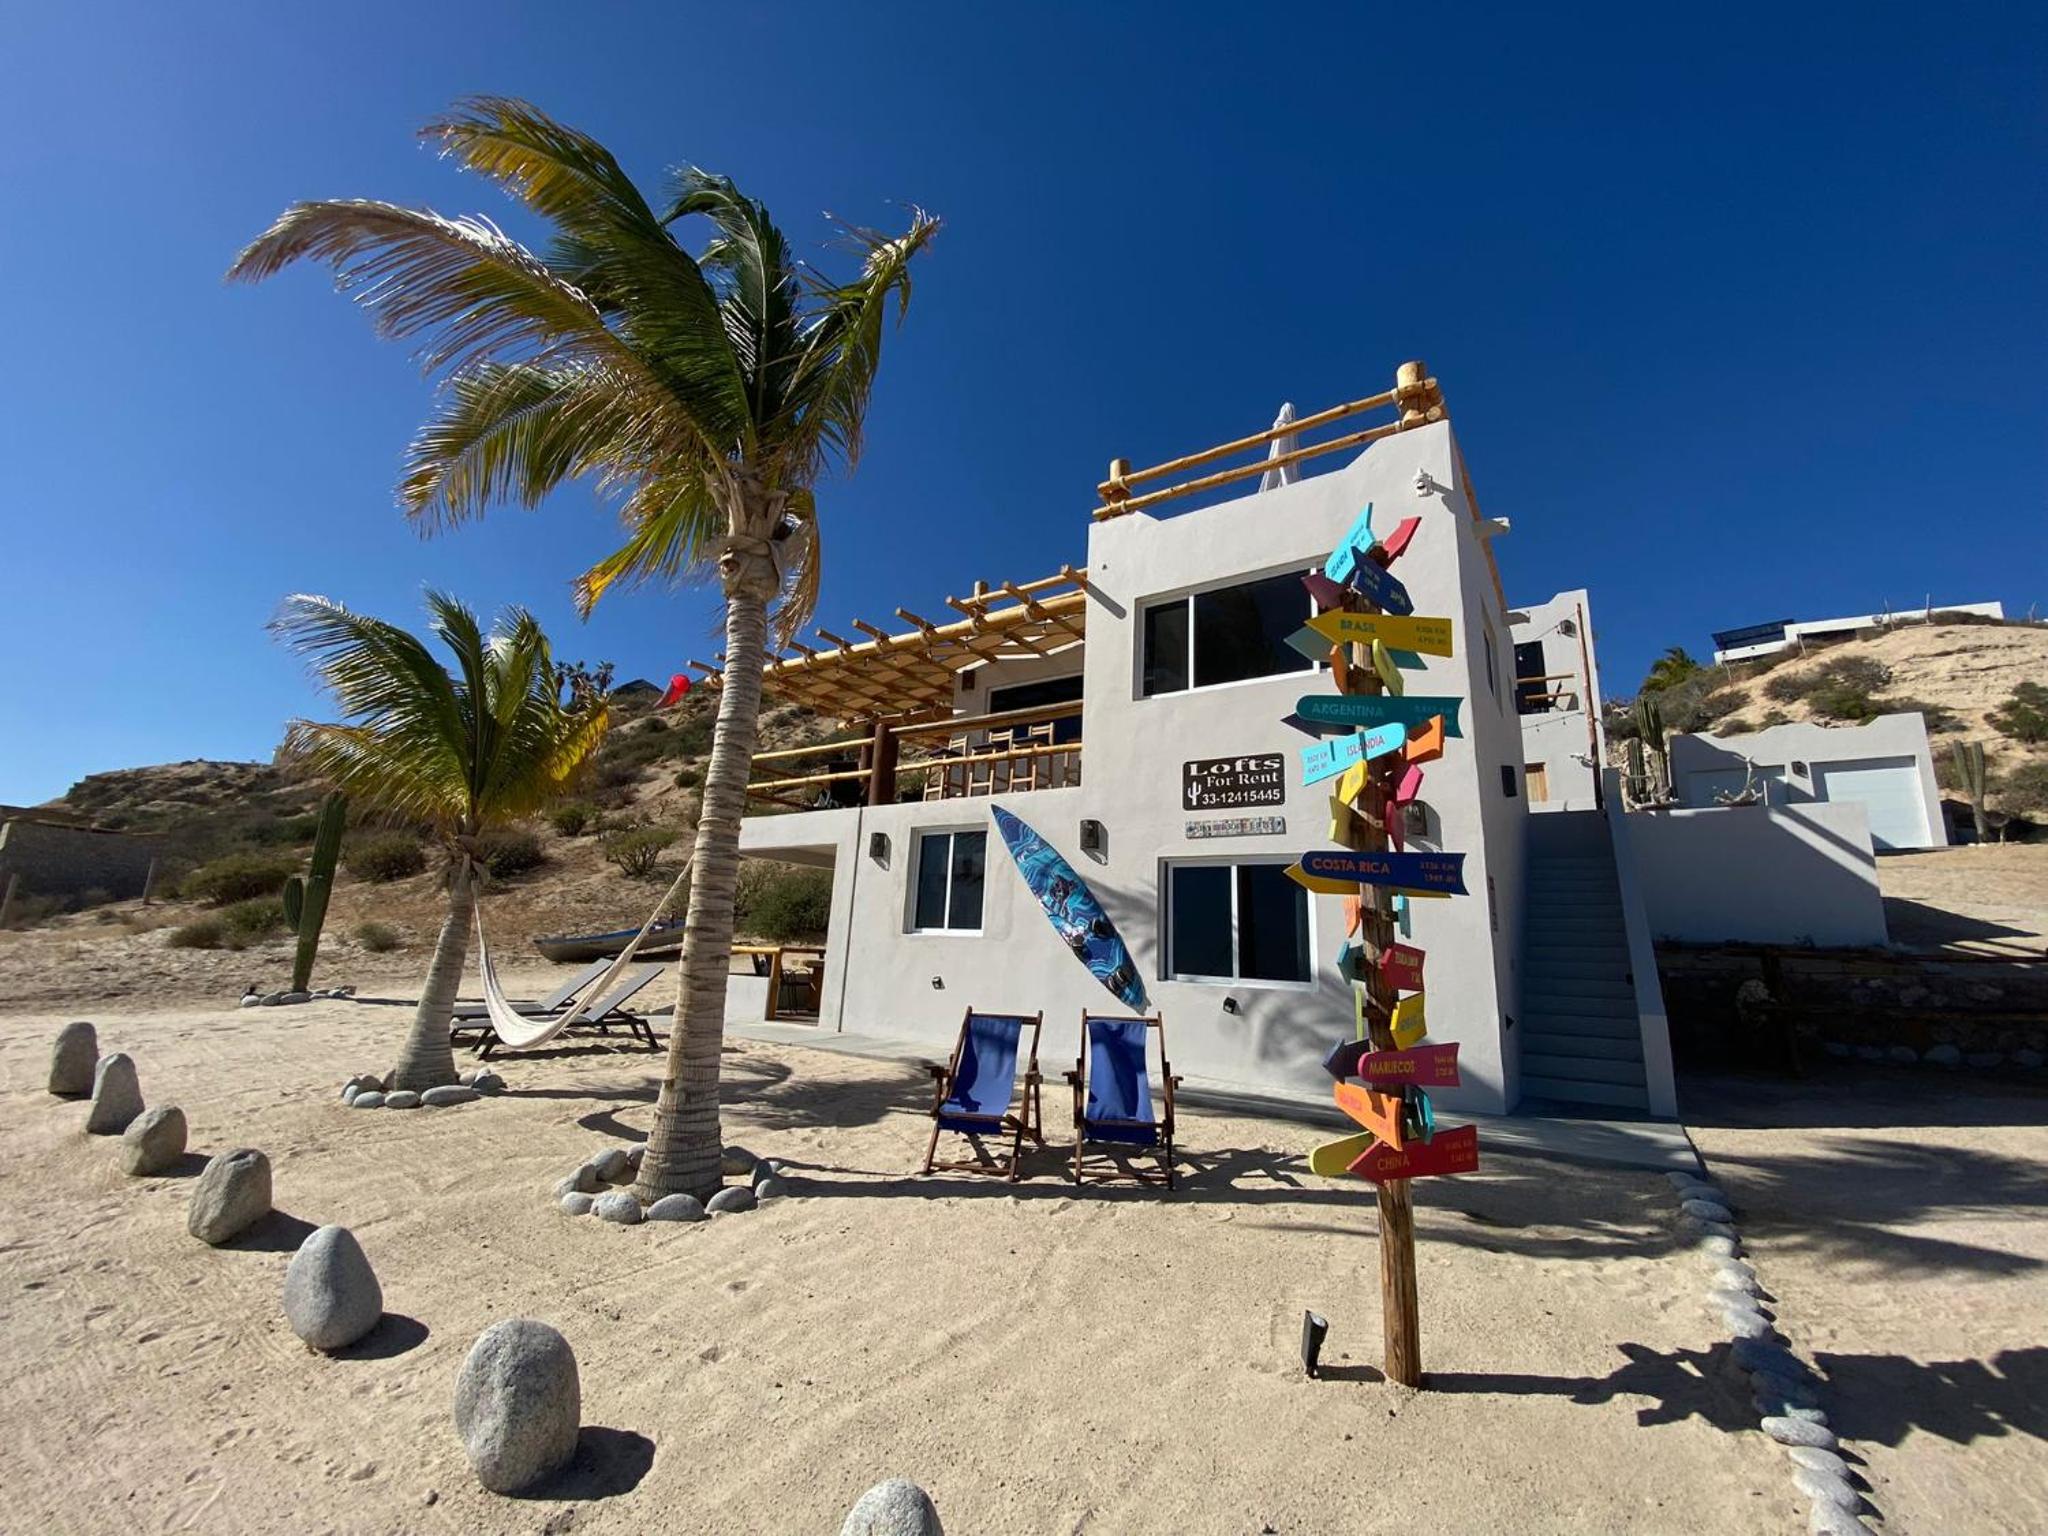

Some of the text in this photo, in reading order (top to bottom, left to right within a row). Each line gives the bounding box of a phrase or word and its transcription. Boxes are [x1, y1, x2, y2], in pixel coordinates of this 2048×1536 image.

[1340, 619, 1376, 633] BRASIL
[1311, 702, 1384, 718] ARGENTINA
[1346, 735, 1386, 756] ISLANDIA
[1190, 758, 1281, 776] Lofts
[1207, 771, 1279, 788] For Rent
[1201, 788, 1281, 805] 33-12415445
[1311, 858, 1391, 874] COSTA RICA
[1377, 1154, 1410, 1172] CHINA
